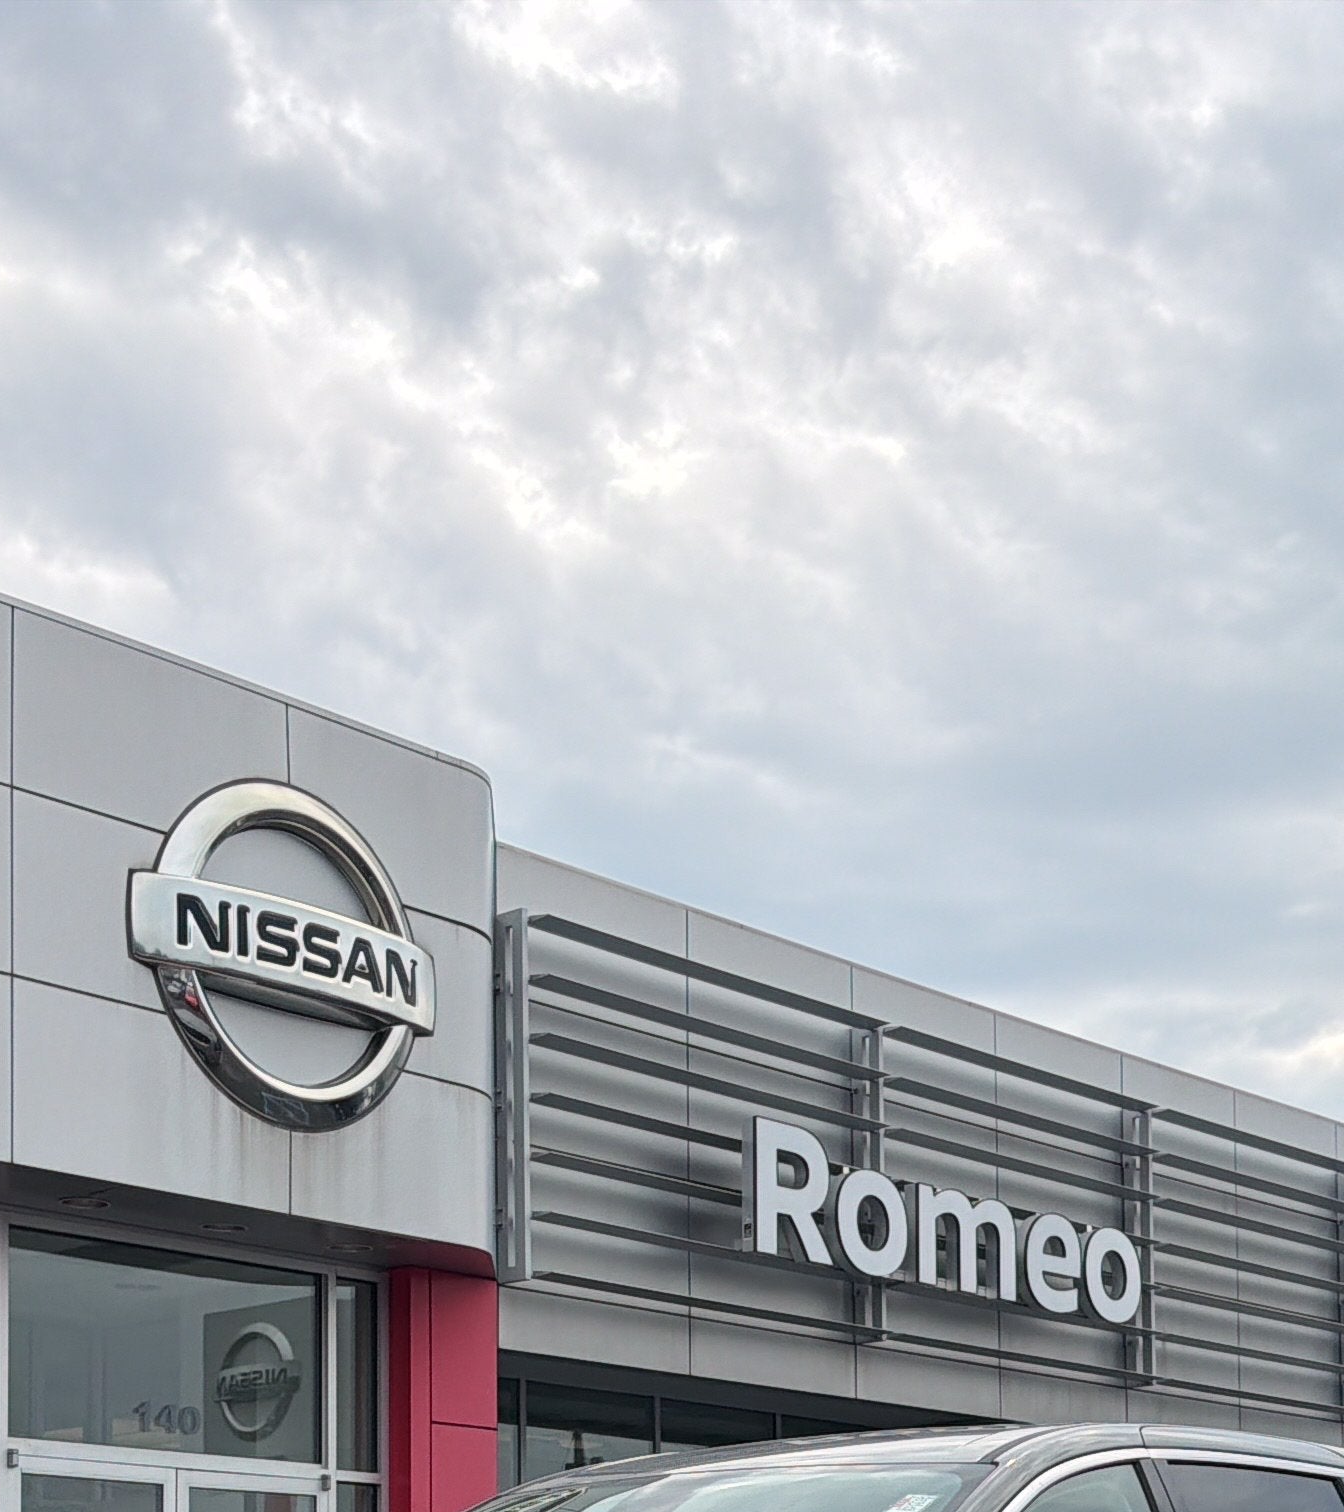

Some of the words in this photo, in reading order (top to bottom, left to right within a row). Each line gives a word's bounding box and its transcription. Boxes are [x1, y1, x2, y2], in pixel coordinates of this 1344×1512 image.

[176, 893, 418, 1007] NISSAN
[752, 1115, 1142, 1324] Romeo
[132, 1400, 201, 1435] 140
